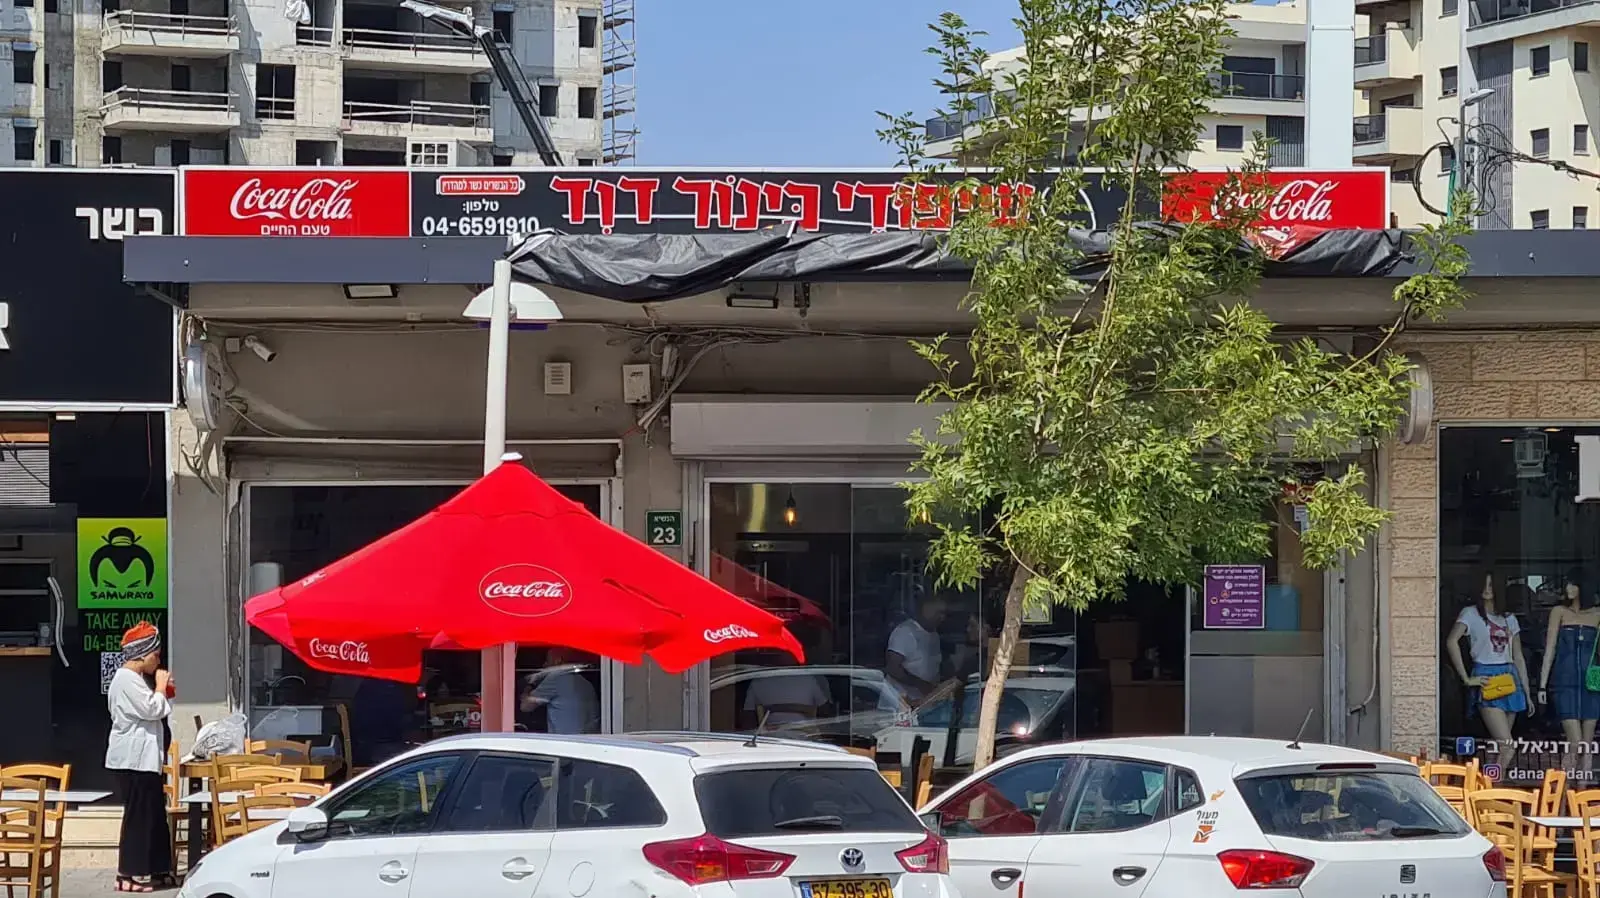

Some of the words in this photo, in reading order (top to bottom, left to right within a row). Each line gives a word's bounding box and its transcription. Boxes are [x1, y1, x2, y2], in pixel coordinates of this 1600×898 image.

[230, 178, 359, 220] Coca-Cola
[462, 198, 500, 214] טלפון:
[75, 207, 163, 239] כשר
[260, 224, 297, 235] החיים
[301, 224, 330, 235] טעם
[422, 216, 540, 236] 04-6591910
[653, 527, 676, 544] 23
[90, 591, 154, 600] SAMURAYO
[485, 581, 565, 599] Coca-Cola
[85, 612, 120, 629] TAKE
[122, 612, 162, 629] AWAY
[309, 638, 370, 663] Coca-Cola
